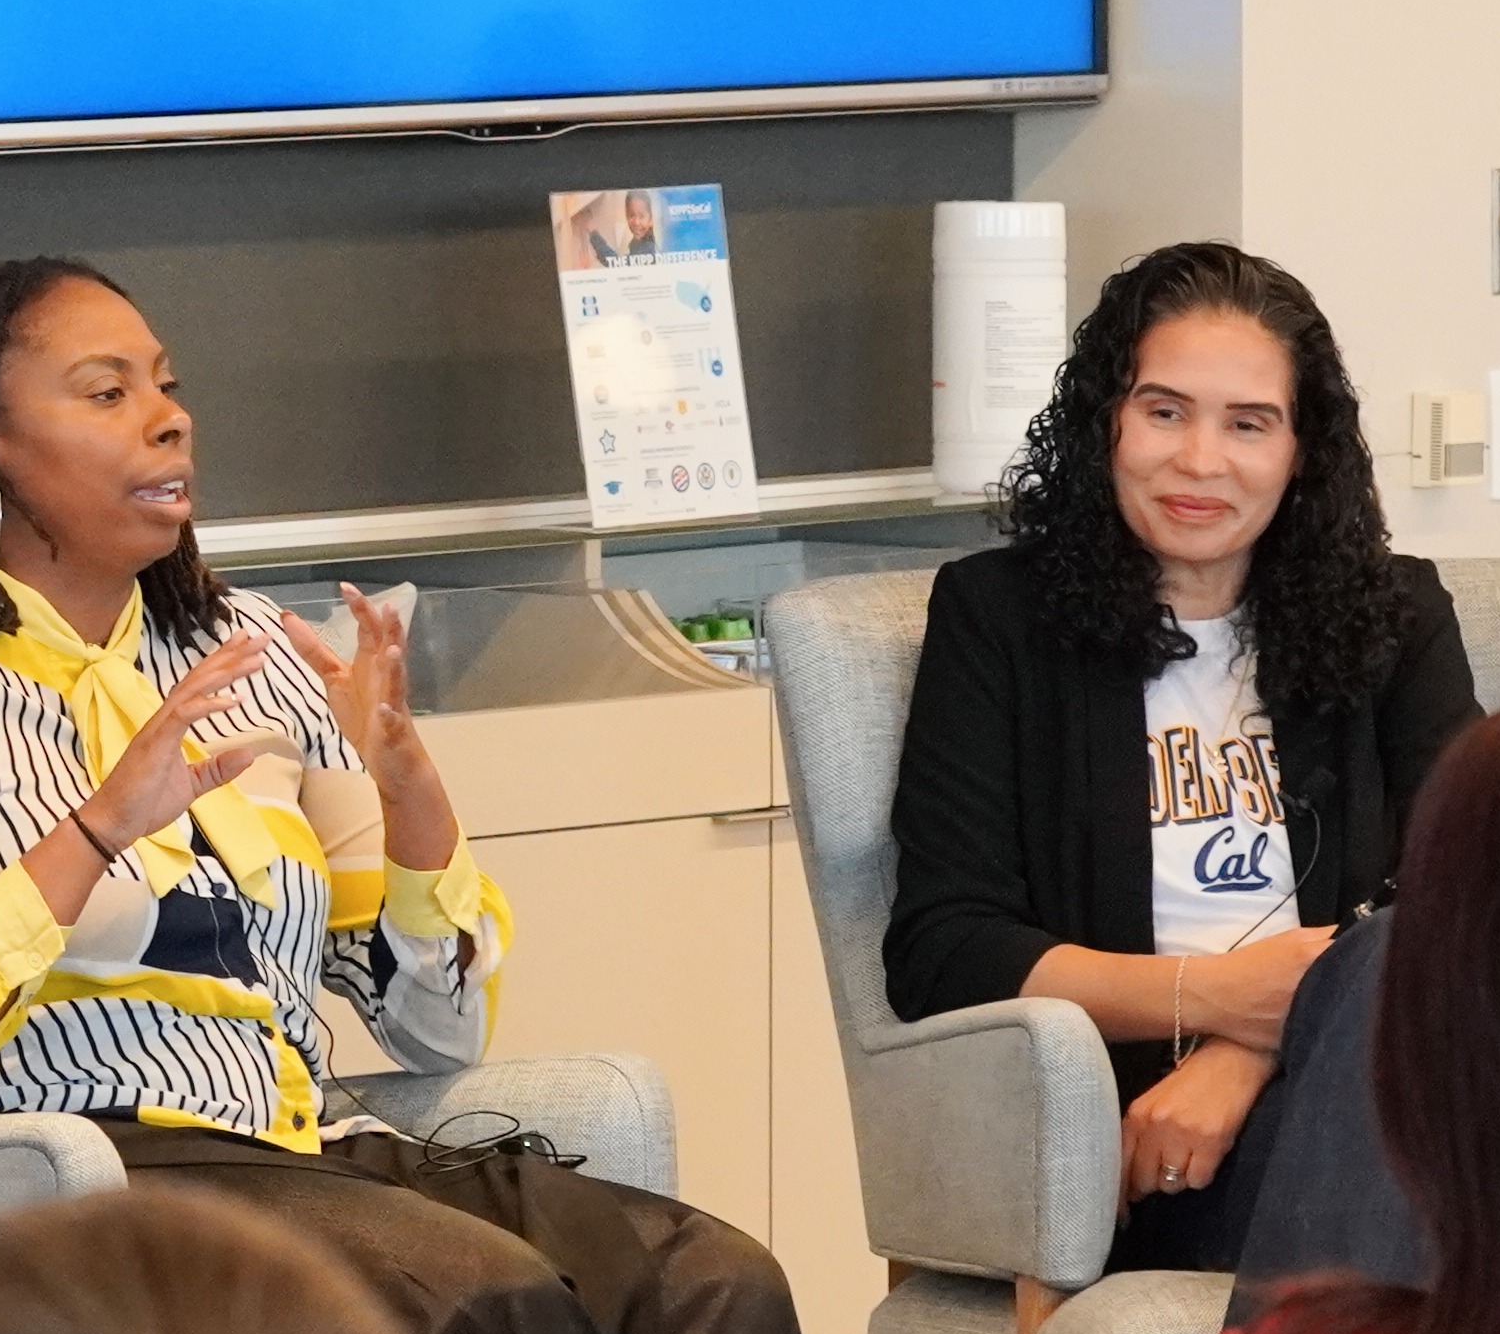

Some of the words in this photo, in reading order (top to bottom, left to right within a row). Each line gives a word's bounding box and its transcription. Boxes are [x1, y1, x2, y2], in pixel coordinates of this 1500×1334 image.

[606, 255, 629, 268] THE
[629, 252, 656, 266] KIPP
[656, 248, 718, 265] DIFFERENCE
[1194, 825, 1273, 893] Cal
